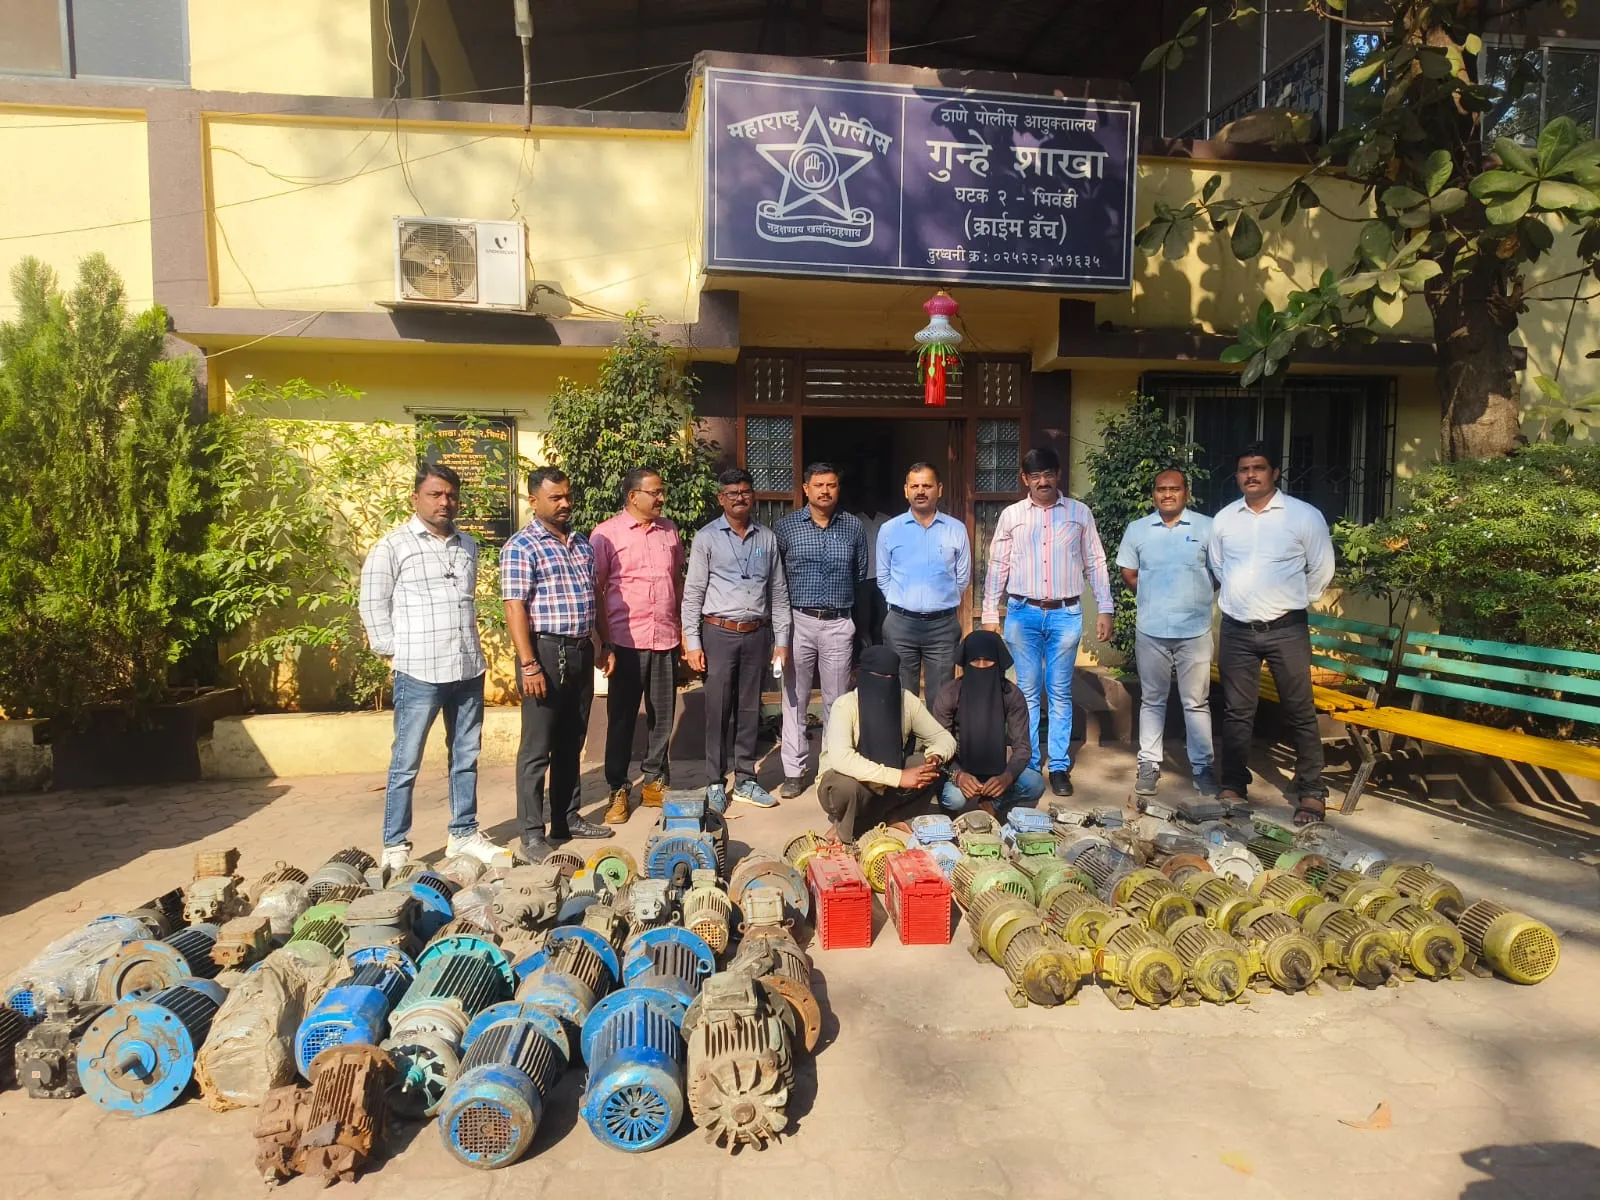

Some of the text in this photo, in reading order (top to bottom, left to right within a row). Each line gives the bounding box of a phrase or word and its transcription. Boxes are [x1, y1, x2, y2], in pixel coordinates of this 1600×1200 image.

[941, 104, 969, 123] ठाणे
[974, 105, 1018, 127] पोलीस
[727, 110, 893, 155] महाराष्ट्र पोलीस
[926, 128, 1109, 183] गुन्हे शाखा
[954, 187, 989, 204] घटक
[997, 190, 1007, 207] २
[1032, 186, 1079, 209] भिवंडी
[964, 209, 1025, 241] (क्राईम
